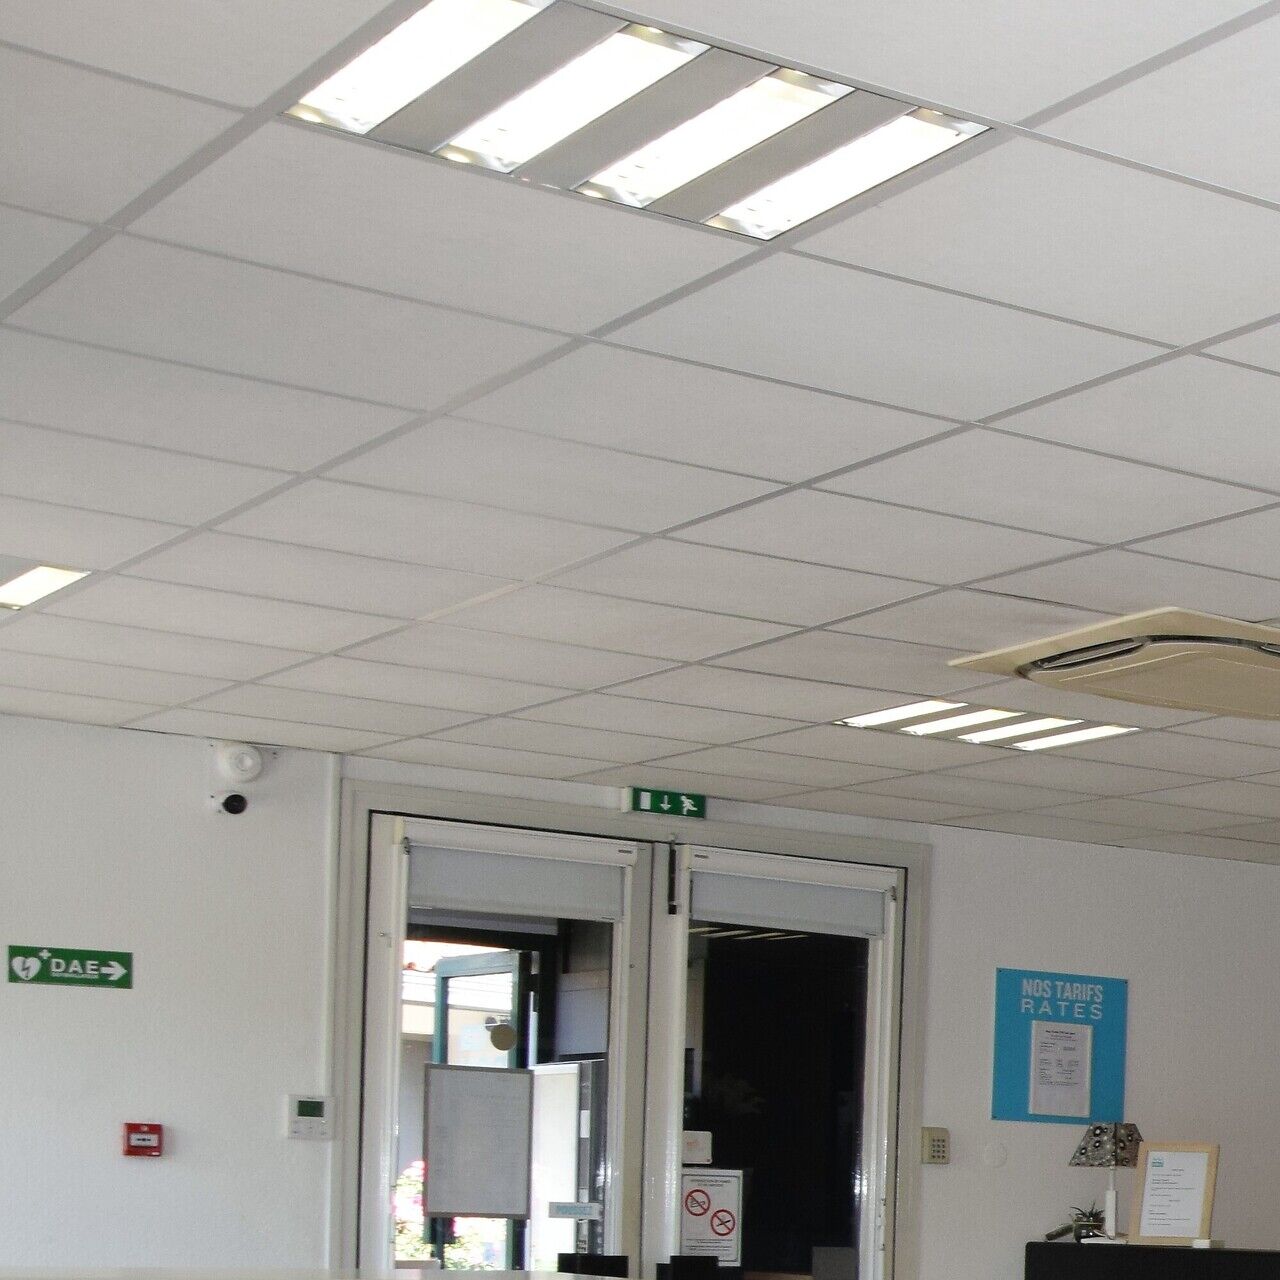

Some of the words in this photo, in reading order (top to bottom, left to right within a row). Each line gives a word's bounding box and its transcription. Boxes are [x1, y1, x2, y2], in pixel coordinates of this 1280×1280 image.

[50, 958, 98, 974] DAE
[1022, 979, 1052, 999] NOS
[1055, 981, 1104, 1003] TARIFS
[1020, 998, 1103, 1020] RATES
